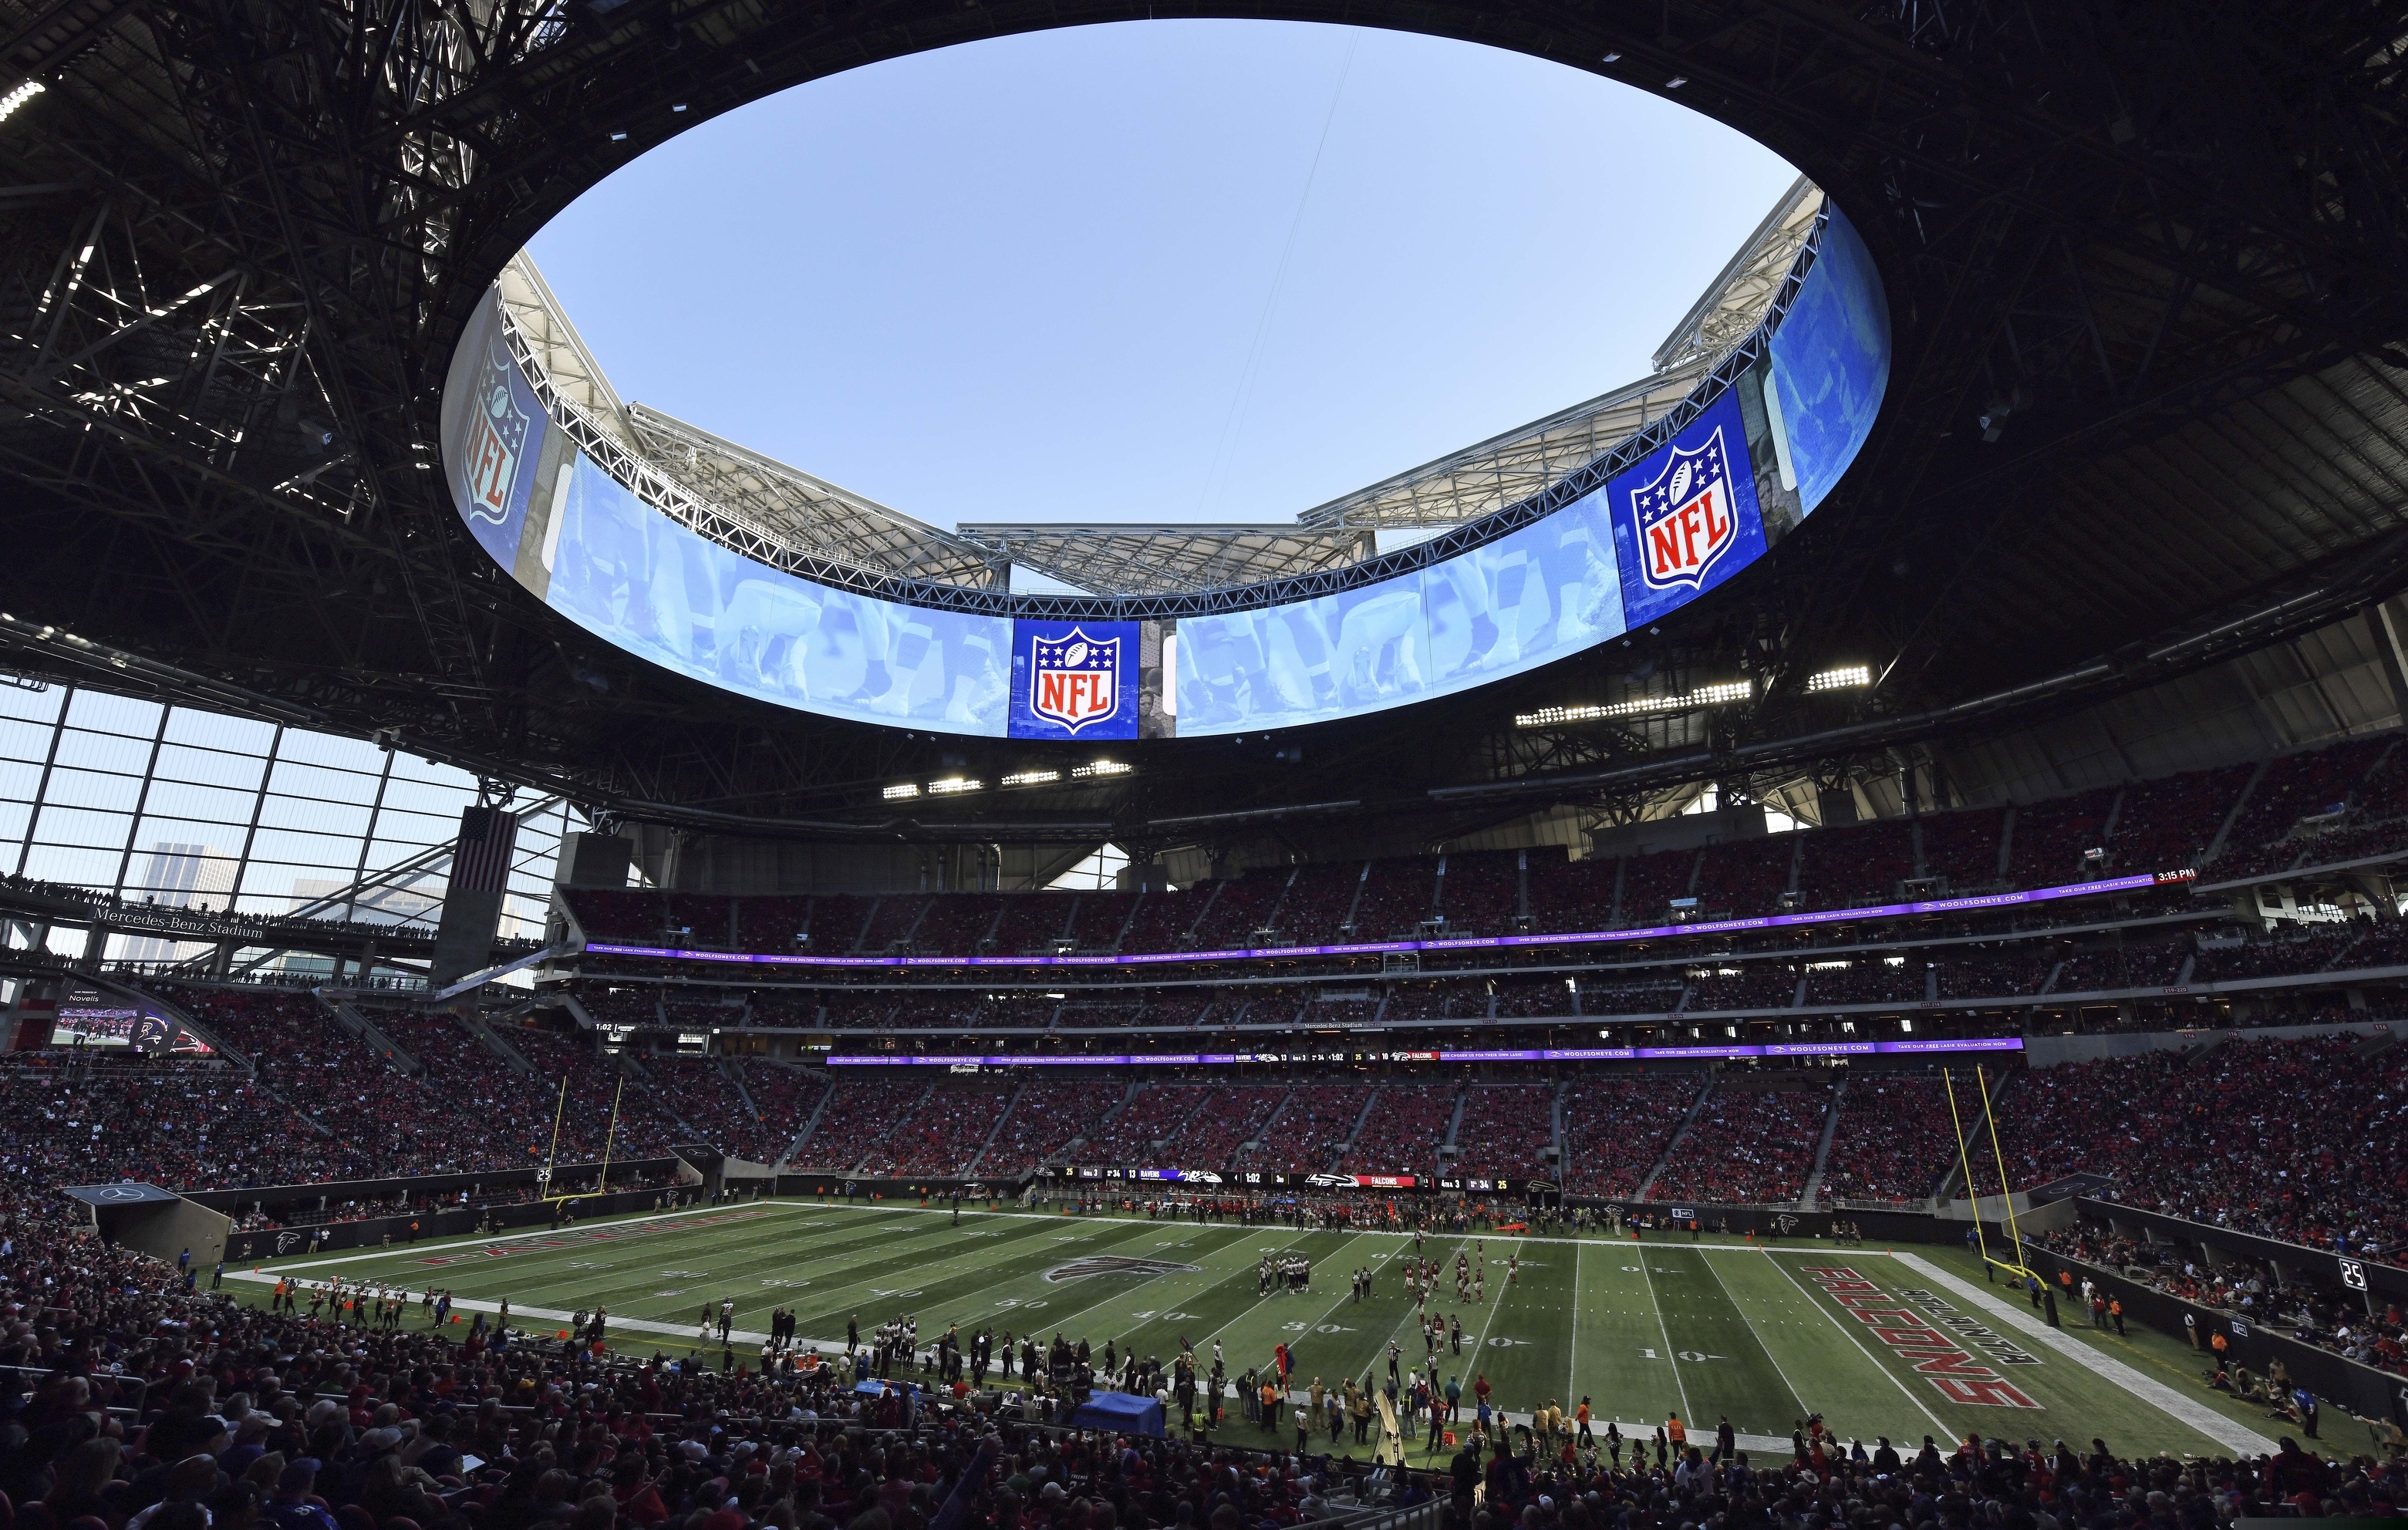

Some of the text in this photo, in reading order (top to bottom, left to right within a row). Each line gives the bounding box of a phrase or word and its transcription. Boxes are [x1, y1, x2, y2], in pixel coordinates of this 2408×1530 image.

[466, 402, 507, 508] NFL
[1650, 490, 1728, 574] NFL
[1041, 673, 1108, 718] NFL
[2158, 868, 2195, 882] 3:15 PM
[1939, 894, 2023, 908] WOOLFSONEYE.COM
[93, 907, 264, 939] Mercedes-Benz Stadium
[1696, 920, 1764, 930] WOOLFSONEYE.COM
[1094, 1168, 1098, 1177] 3
[1113, 1169, 1120, 1178] 34
[1129, 1169, 1136, 1179] 13
[1246, 1173, 1260, 1183] 1:02
[1371, 1177, 1397, 1185] FALCONS
[1455, 1179, 1460, 1188] 3
[1479, 1180, 1489, 1189] 34
[1498, 1180, 1507, 1189] 25
[2342, 1262, 2365, 1287] 25
[1891, 1288, 2044, 1365] ATLANTA
[1799, 1267, 2046, 1409] FALCONS
